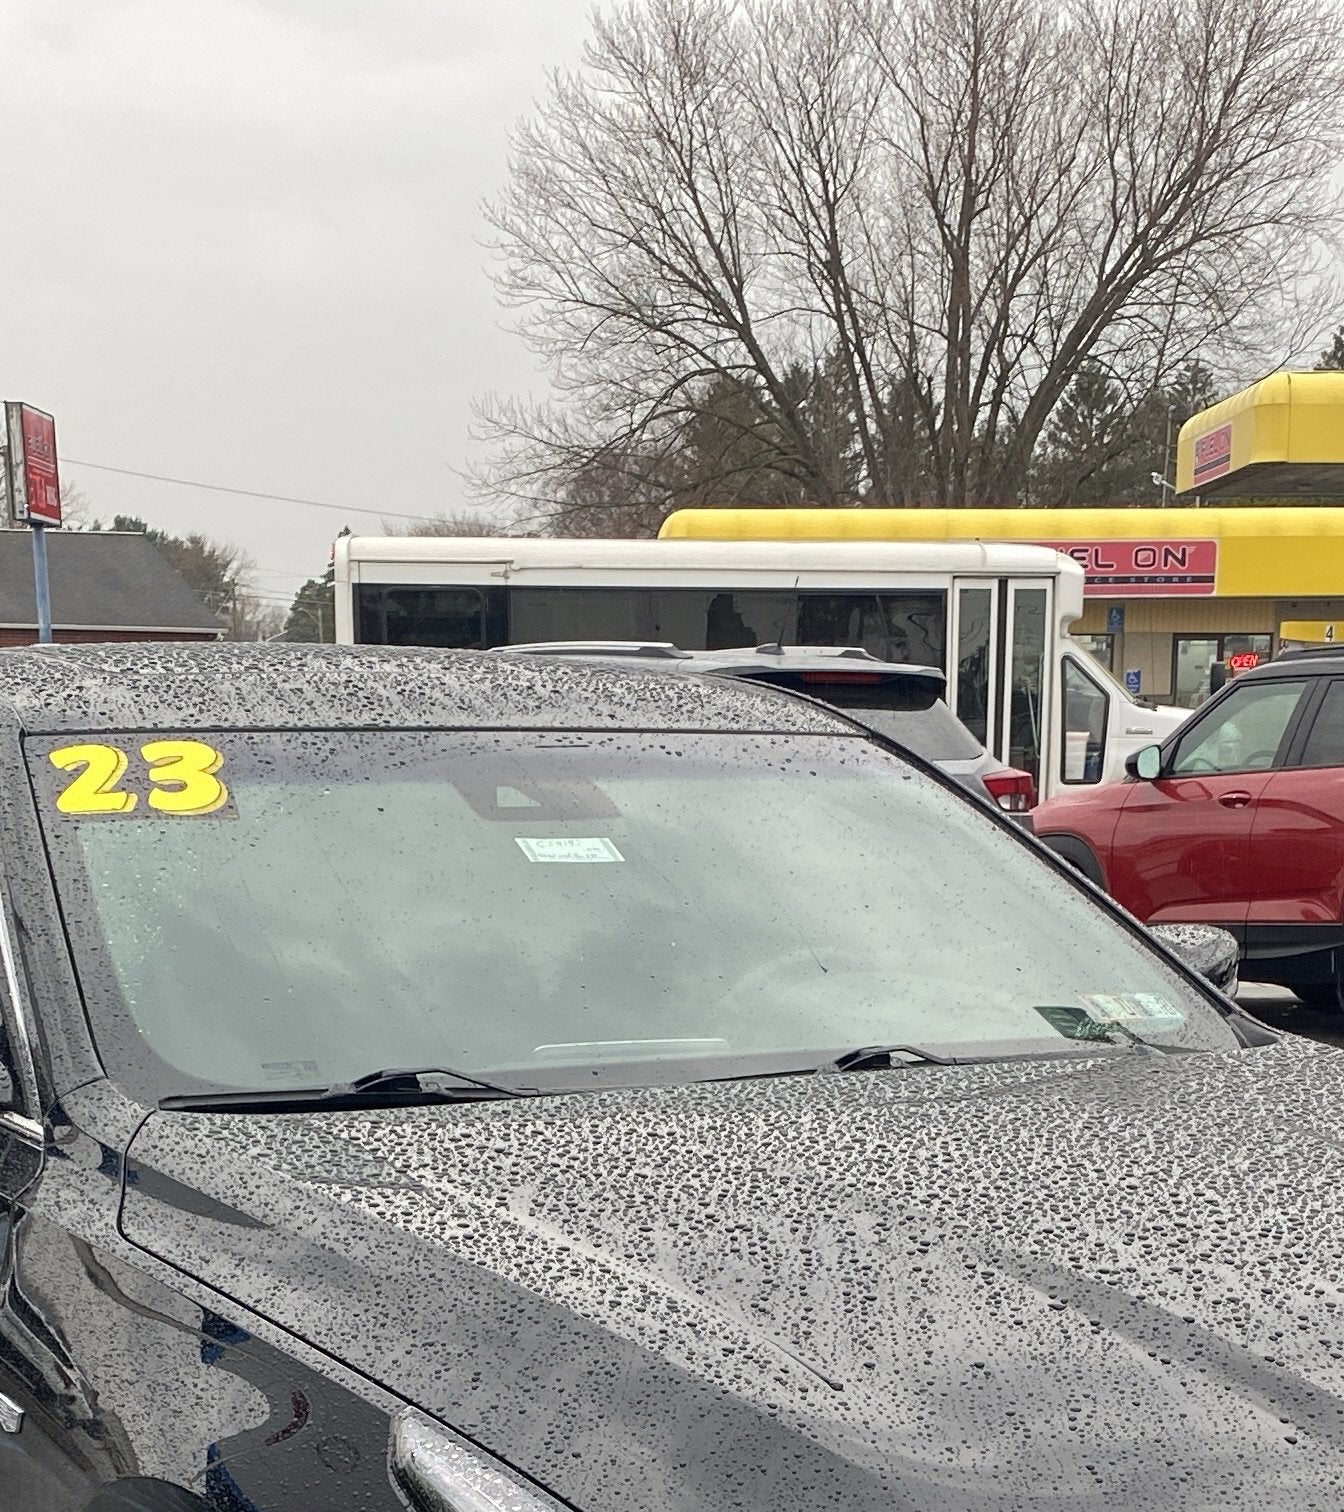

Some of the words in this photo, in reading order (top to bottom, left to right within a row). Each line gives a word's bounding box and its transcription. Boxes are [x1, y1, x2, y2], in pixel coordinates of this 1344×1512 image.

[1133, 546, 1187, 569] ON
[1325, 625, 1334, 640] 4
[1230, 654, 1259, 667] OPEN
[48, 739, 230, 817] 23
